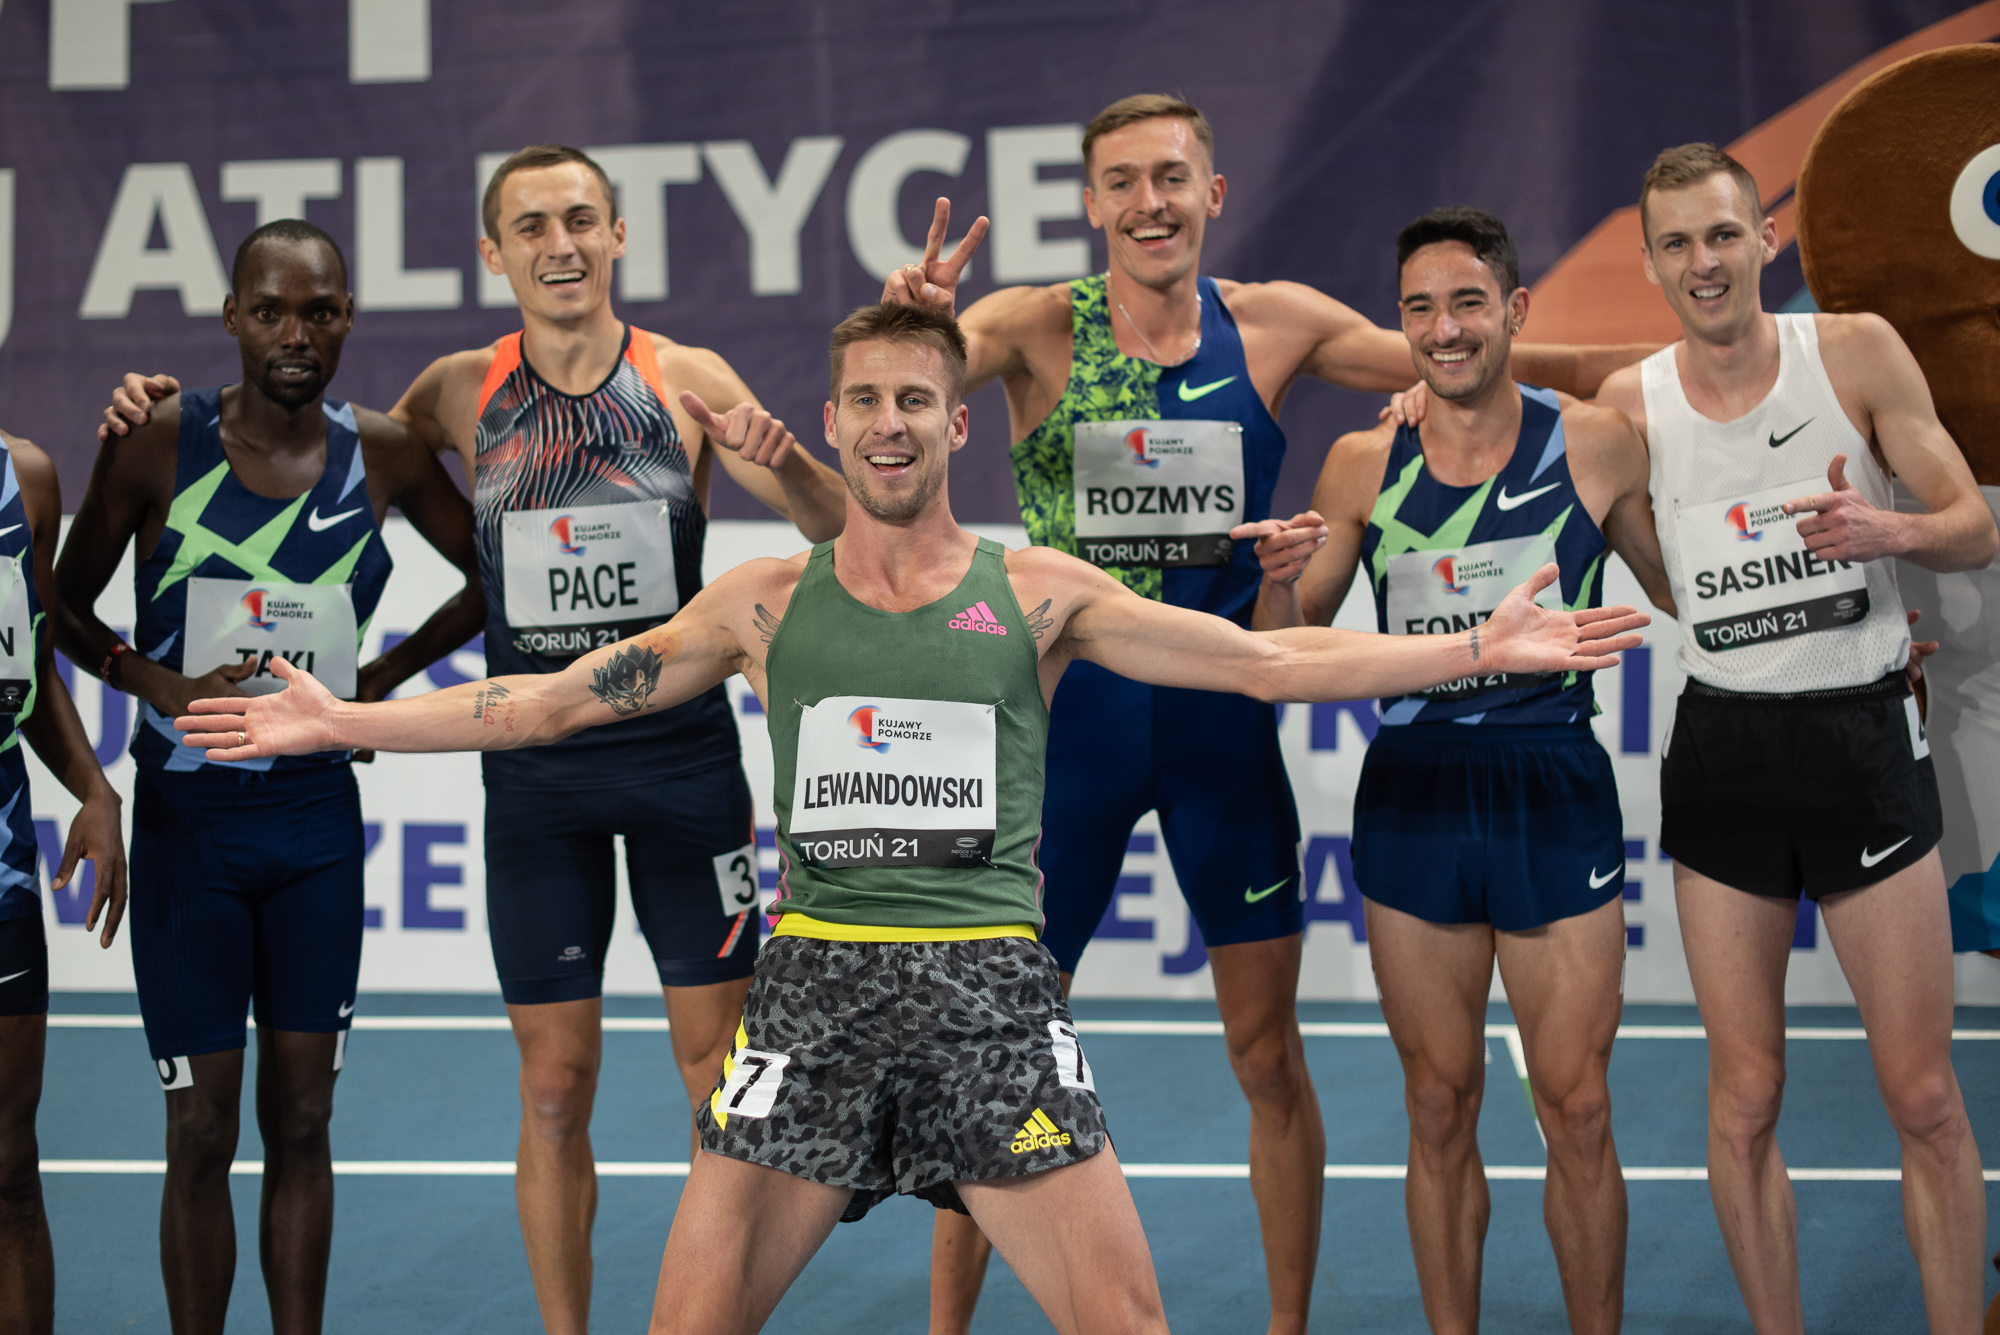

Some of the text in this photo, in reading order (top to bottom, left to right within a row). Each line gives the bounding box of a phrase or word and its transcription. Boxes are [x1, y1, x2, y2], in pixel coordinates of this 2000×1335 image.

[78, 124, 1092, 320] ATLTYCE
[1149, 438, 1185, 446] KUJAWY
[1149, 446, 1194, 455] POMORZE
[1087, 484, 1235, 516] ROZMYS
[574, 522, 612, 533] KUJAWY
[574, 530, 622, 542] POMORZE
[1086, 538, 1160, 562] TORUŃ
[1165, 542, 1188, 561] 21
[1457, 560, 1494, 573] KUJAWY
[1458, 567, 1505, 582] POMORZE
[548, 561, 639, 612] PACE
[266, 600, 306, 610] KUJAWY
[266, 609, 314, 619] POMORZE
[948, 618, 1007, 636] adidas
[1704, 611, 1779, 647] TORUŃ
[1784, 610, 1808, 631] 21
[520, 627, 621, 652] TORUŃ 21
[878, 718, 923, 730] KUJAWY
[877, 728, 933, 741] POMORZE
[803, 771, 984, 810] LEWANDOWSKI
[800, 832, 919, 861] TORUŃ 21
[730, 854, 756, 905] 3
[729, 1055, 775, 1108] 7
[1010, 1132, 1072, 1154] adidas
